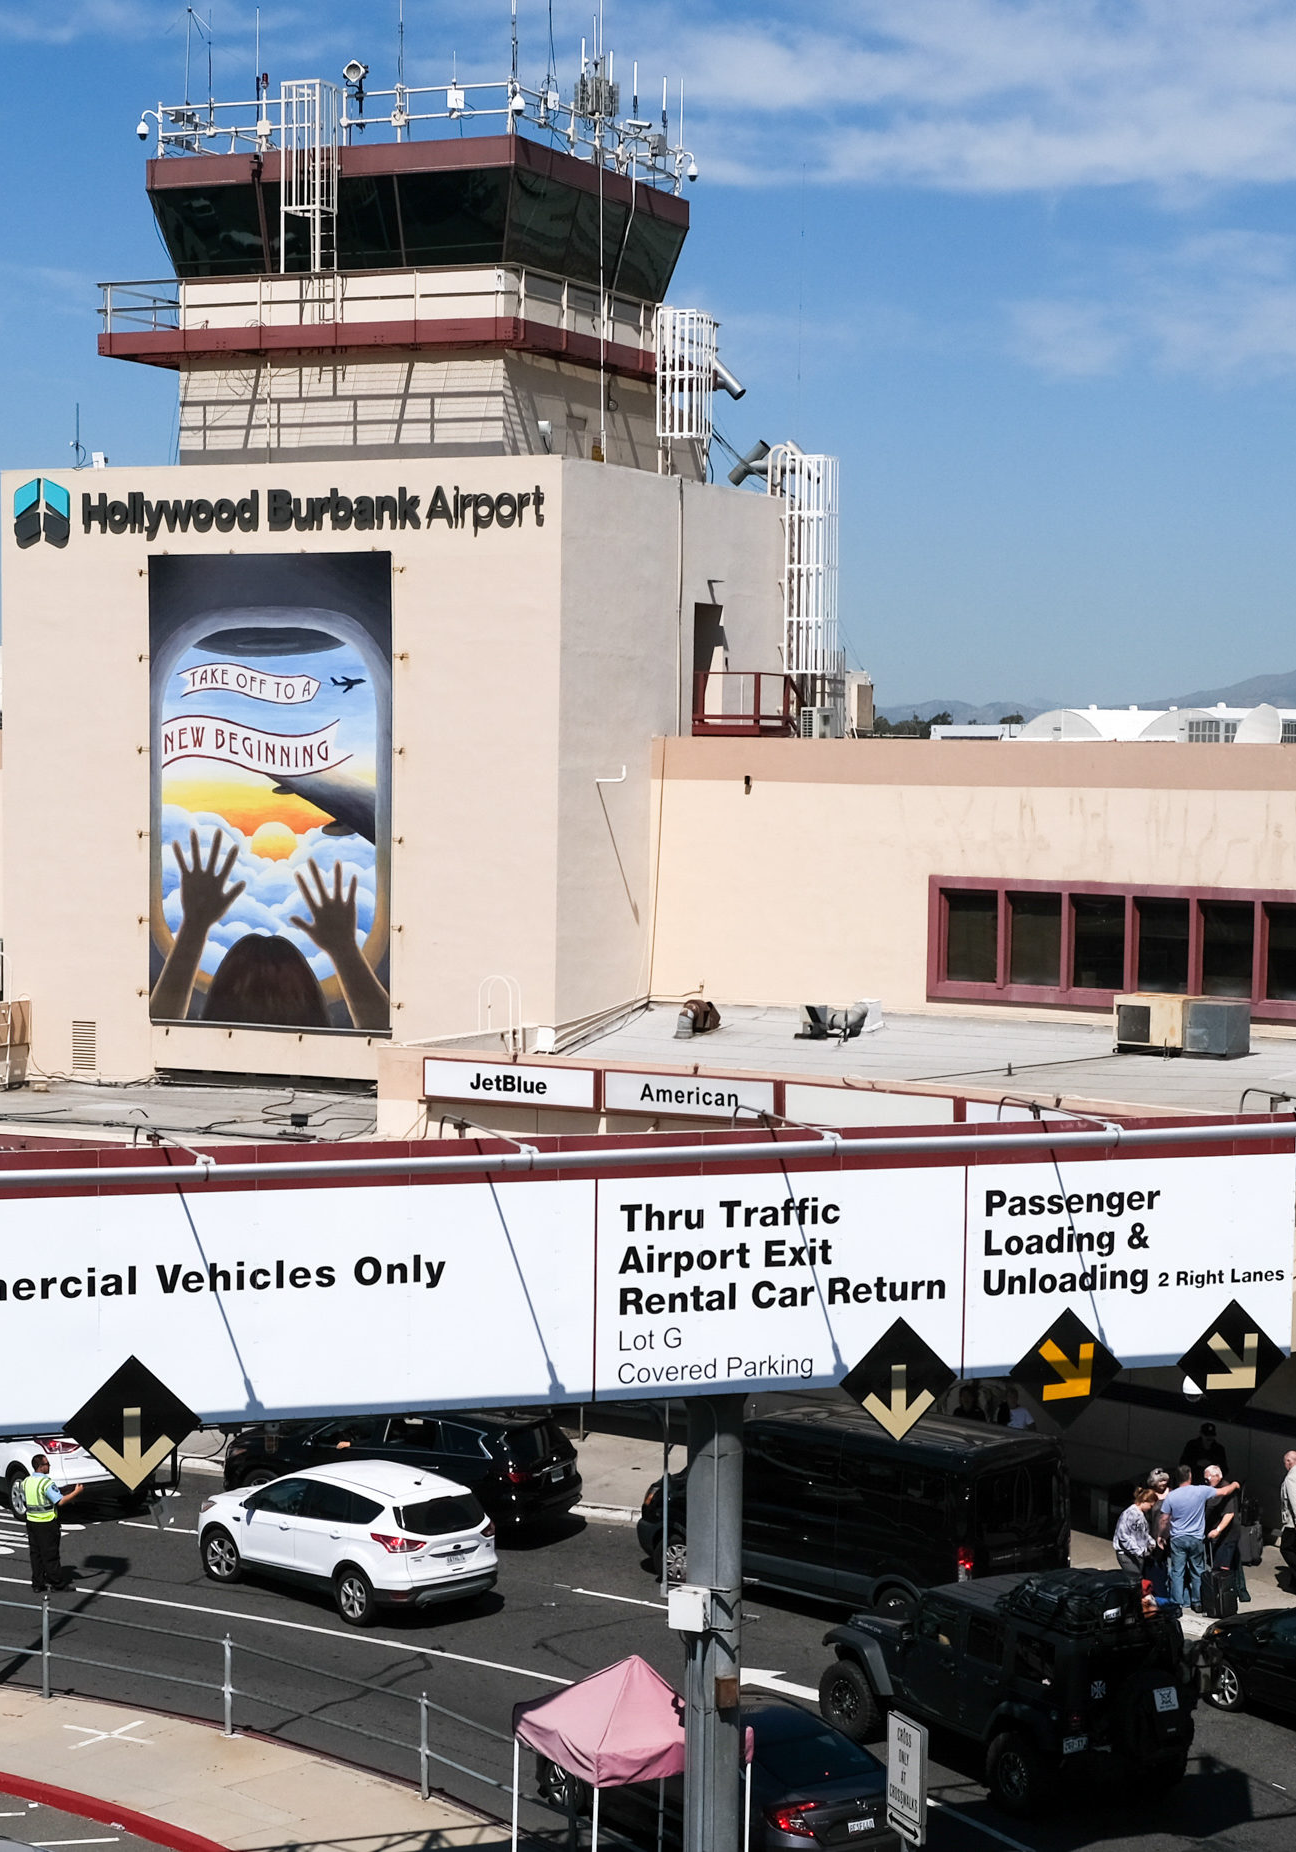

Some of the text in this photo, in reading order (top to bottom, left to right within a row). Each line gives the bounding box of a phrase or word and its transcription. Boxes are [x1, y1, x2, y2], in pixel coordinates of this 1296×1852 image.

[82, 485, 545, 541] Hollywood Burbank Airport
[189, 667, 312, 700] TAKE OFF TO A
[164, 726, 330, 769] NEW BEGINNING
[469, 1072, 548, 1096] JetBlue
[639, 1083, 740, 1108] American
[620, 1196, 840, 1232] Thru Traffic
[985, 1189, 1161, 1218] Passenger
[984, 1222, 1150, 1257] Loading &
[156, 1261, 336, 1295] Vehicles
[354, 1254, 446, 1289] Only
[618, 1238, 832, 1278] Airport Exit
[619, 1276, 946, 1316] Rental Car Return
[983, 1263, 1285, 1296] Unloading 2 Right Lanes
[618, 1326, 683, 1352] Lot G
[617, 1354, 814, 1385] Covered Parking
[898, 1748, 910, 1767] ONLY
[889, 1782, 918, 1814] CROSSWALKS
